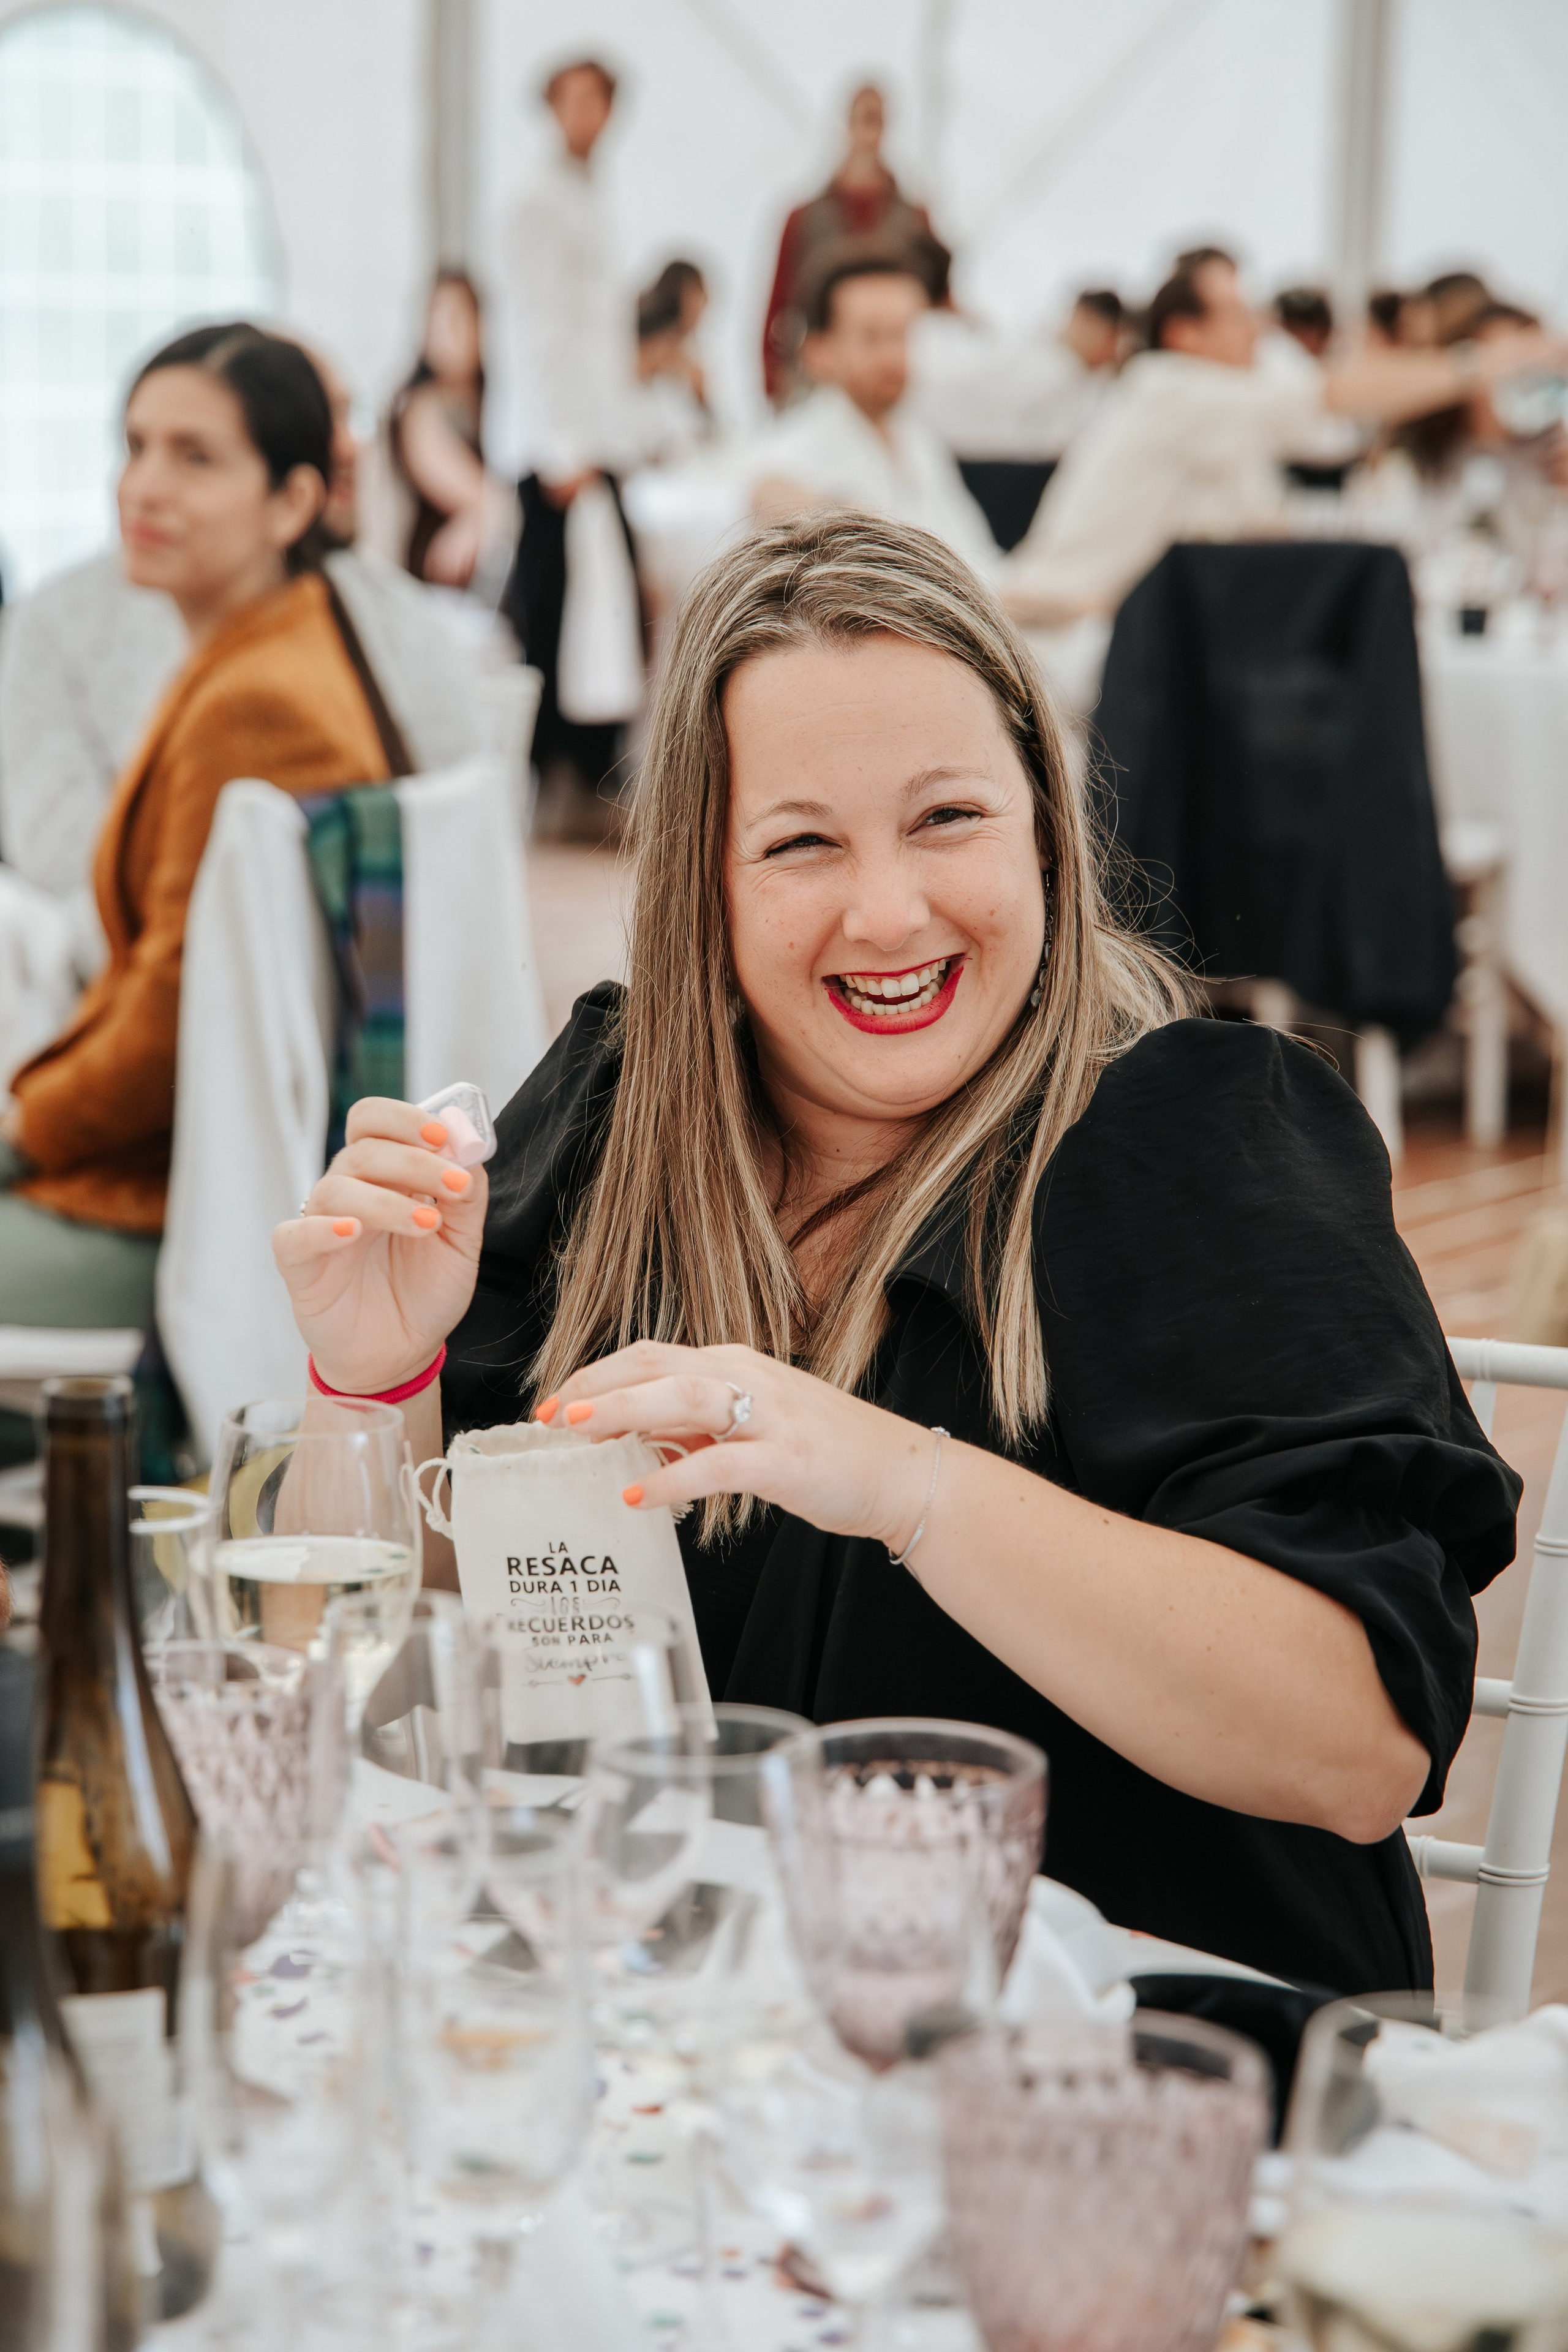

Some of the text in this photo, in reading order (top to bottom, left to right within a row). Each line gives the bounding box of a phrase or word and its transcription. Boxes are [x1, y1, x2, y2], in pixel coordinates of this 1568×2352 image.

[549, 1542, 568, 1553] LA
[507, 1556, 619, 1576] RESACA
[510, 1580, 621, 1594] DURA 1 DIA
[568, 1633, 613, 1645] PARA
